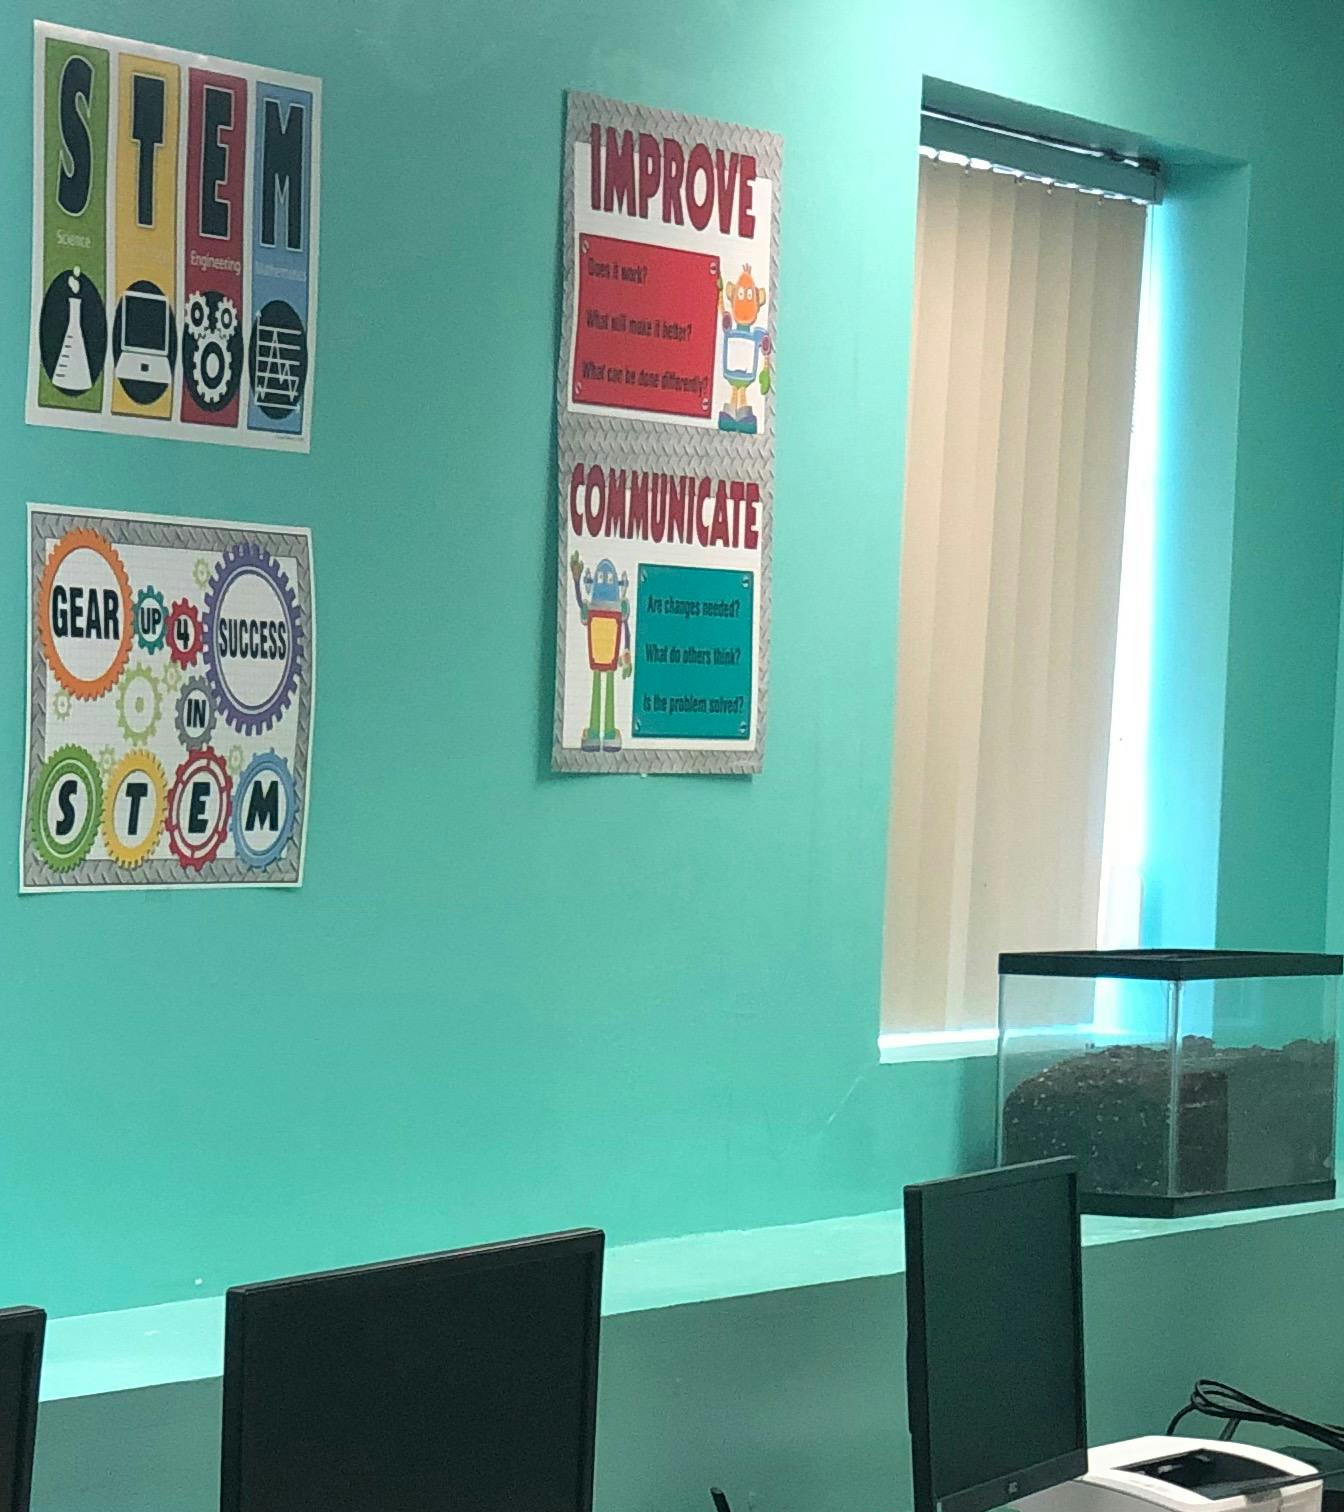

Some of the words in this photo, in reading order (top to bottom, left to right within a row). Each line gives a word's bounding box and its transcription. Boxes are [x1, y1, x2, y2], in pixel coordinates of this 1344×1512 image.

[590, 123, 757, 239] IMPROVE
[56, 230, 92, 248] Science
[190, 251, 241, 275] Engineering
[588, 258, 610, 280] Does
[612, 261, 619, 280] it
[621, 264, 647, 286] work?
[570, 463, 760, 550] COMMUNICATE
[648, 596, 661, 612] Are
[664, 598, 700, 618] changes
[703, 599, 740, 618] needed?
[53, 584, 120, 640] GEAR
[141, 607, 162, 634] UP
[176, 619, 190, 650] 4
[219, 617, 287, 661] SUCCESS
[646, 644, 668, 663] What
[670, 646, 680, 663] do
[683, 646, 710, 665] others
[714, 647, 741, 666] think?
[187, 699, 205, 729] IN
[643, 692, 651, 711] Is
[654, 694, 667, 712] the
[669, 694, 706, 715] problem
[709, 696, 744, 714] solved?
